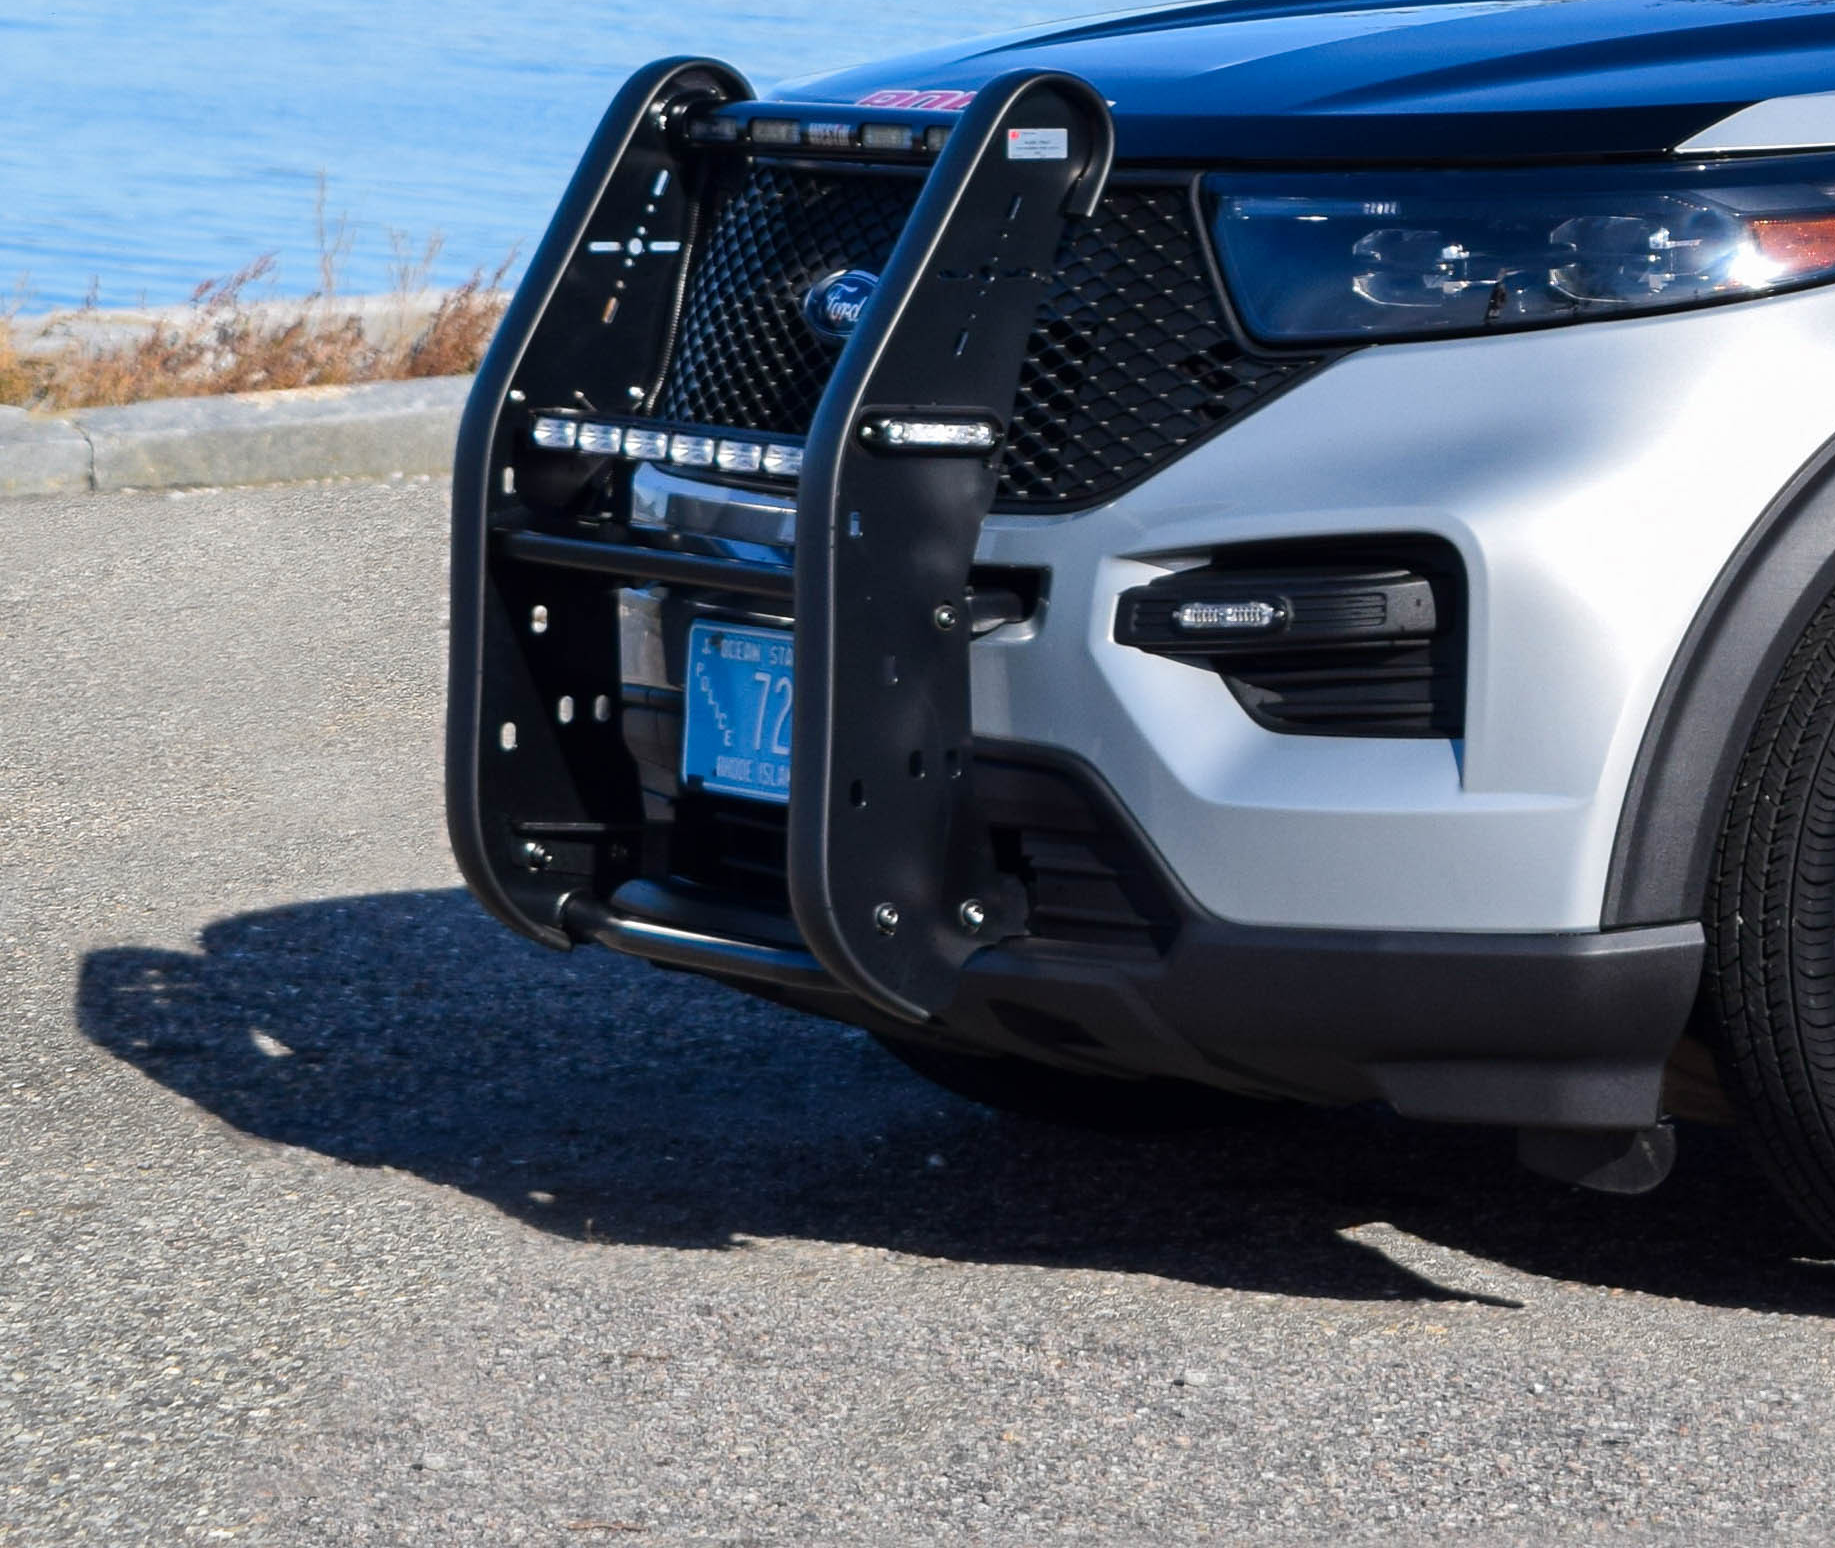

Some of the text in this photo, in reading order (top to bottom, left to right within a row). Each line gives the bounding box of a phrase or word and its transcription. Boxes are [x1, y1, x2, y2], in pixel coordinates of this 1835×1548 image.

[826, 283, 868, 322] Ford
[769, 645, 793, 667] STA
[696, 661, 734, 747] POLICE
